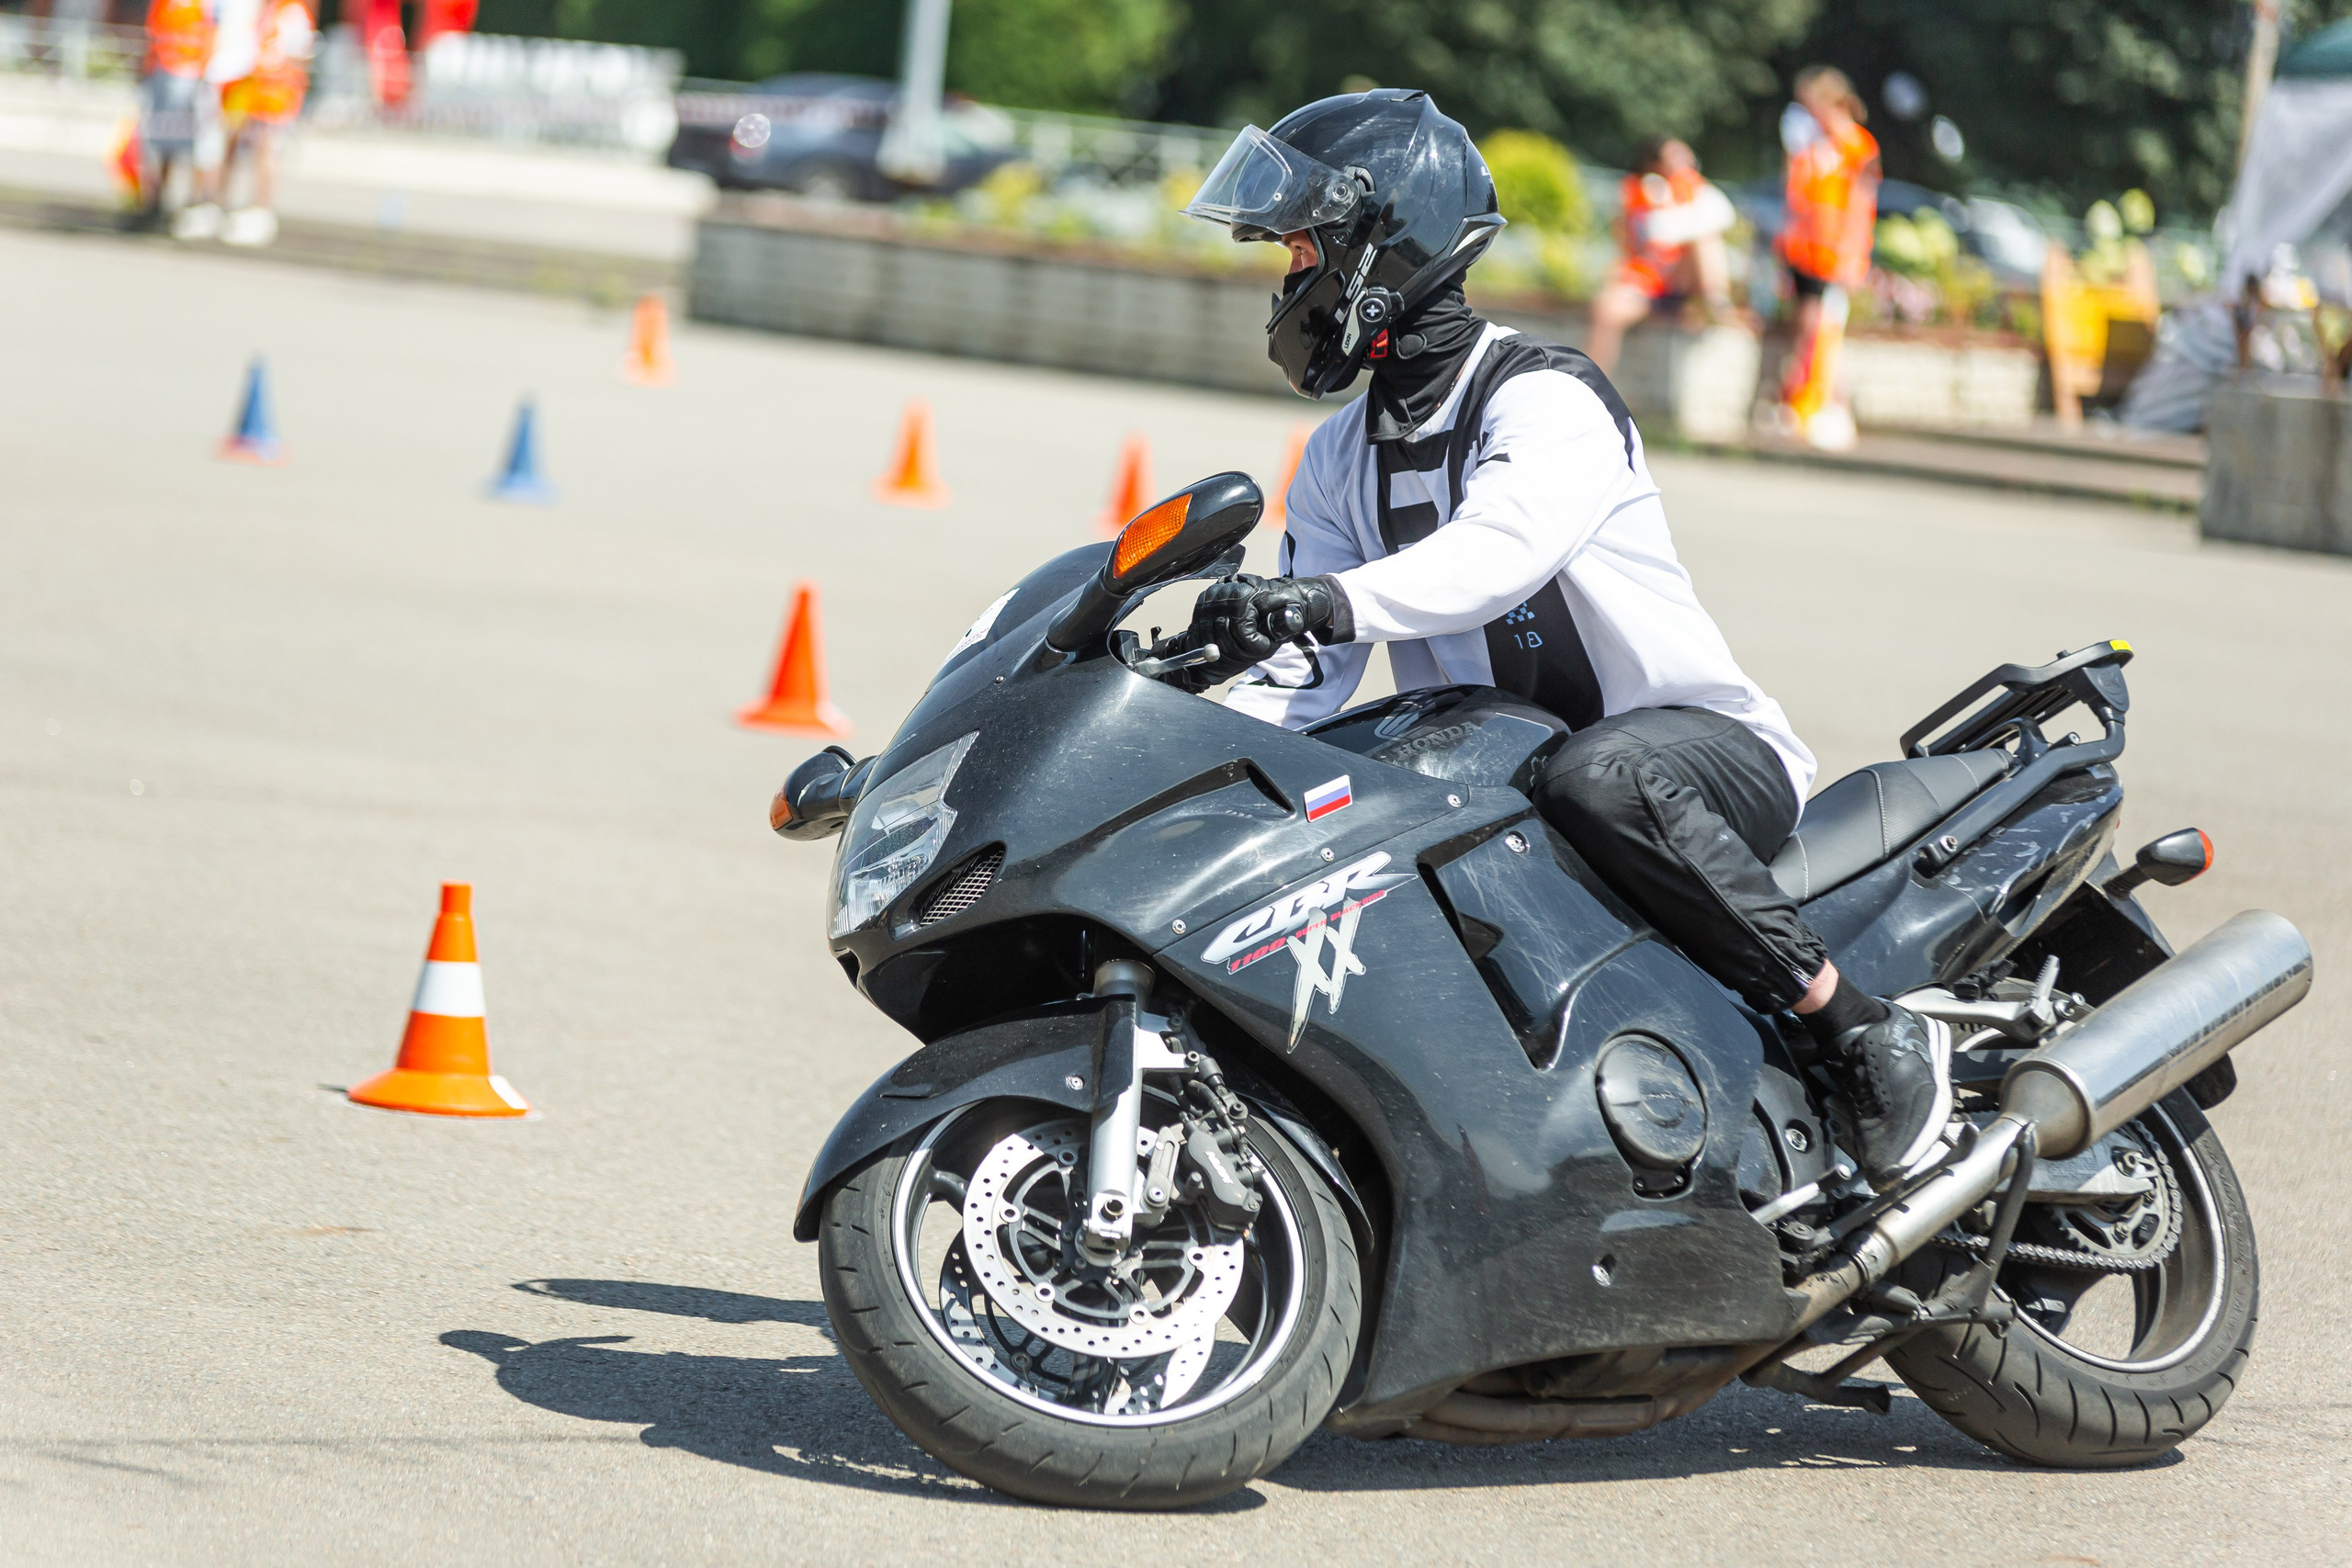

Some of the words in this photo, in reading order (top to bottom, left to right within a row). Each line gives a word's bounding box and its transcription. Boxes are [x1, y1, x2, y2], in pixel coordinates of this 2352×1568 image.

[1334, 243, 1377, 323] LS2
[1392, 721, 1482, 755] HONDA
[1202, 852, 1418, 964] CBR
[1229, 937, 1287, 972] 1100
[1295, 919, 1328, 939] SUPER
[1330, 889, 1386, 922] BLACKBIRD
[1286, 896, 1366, 1054] XX
